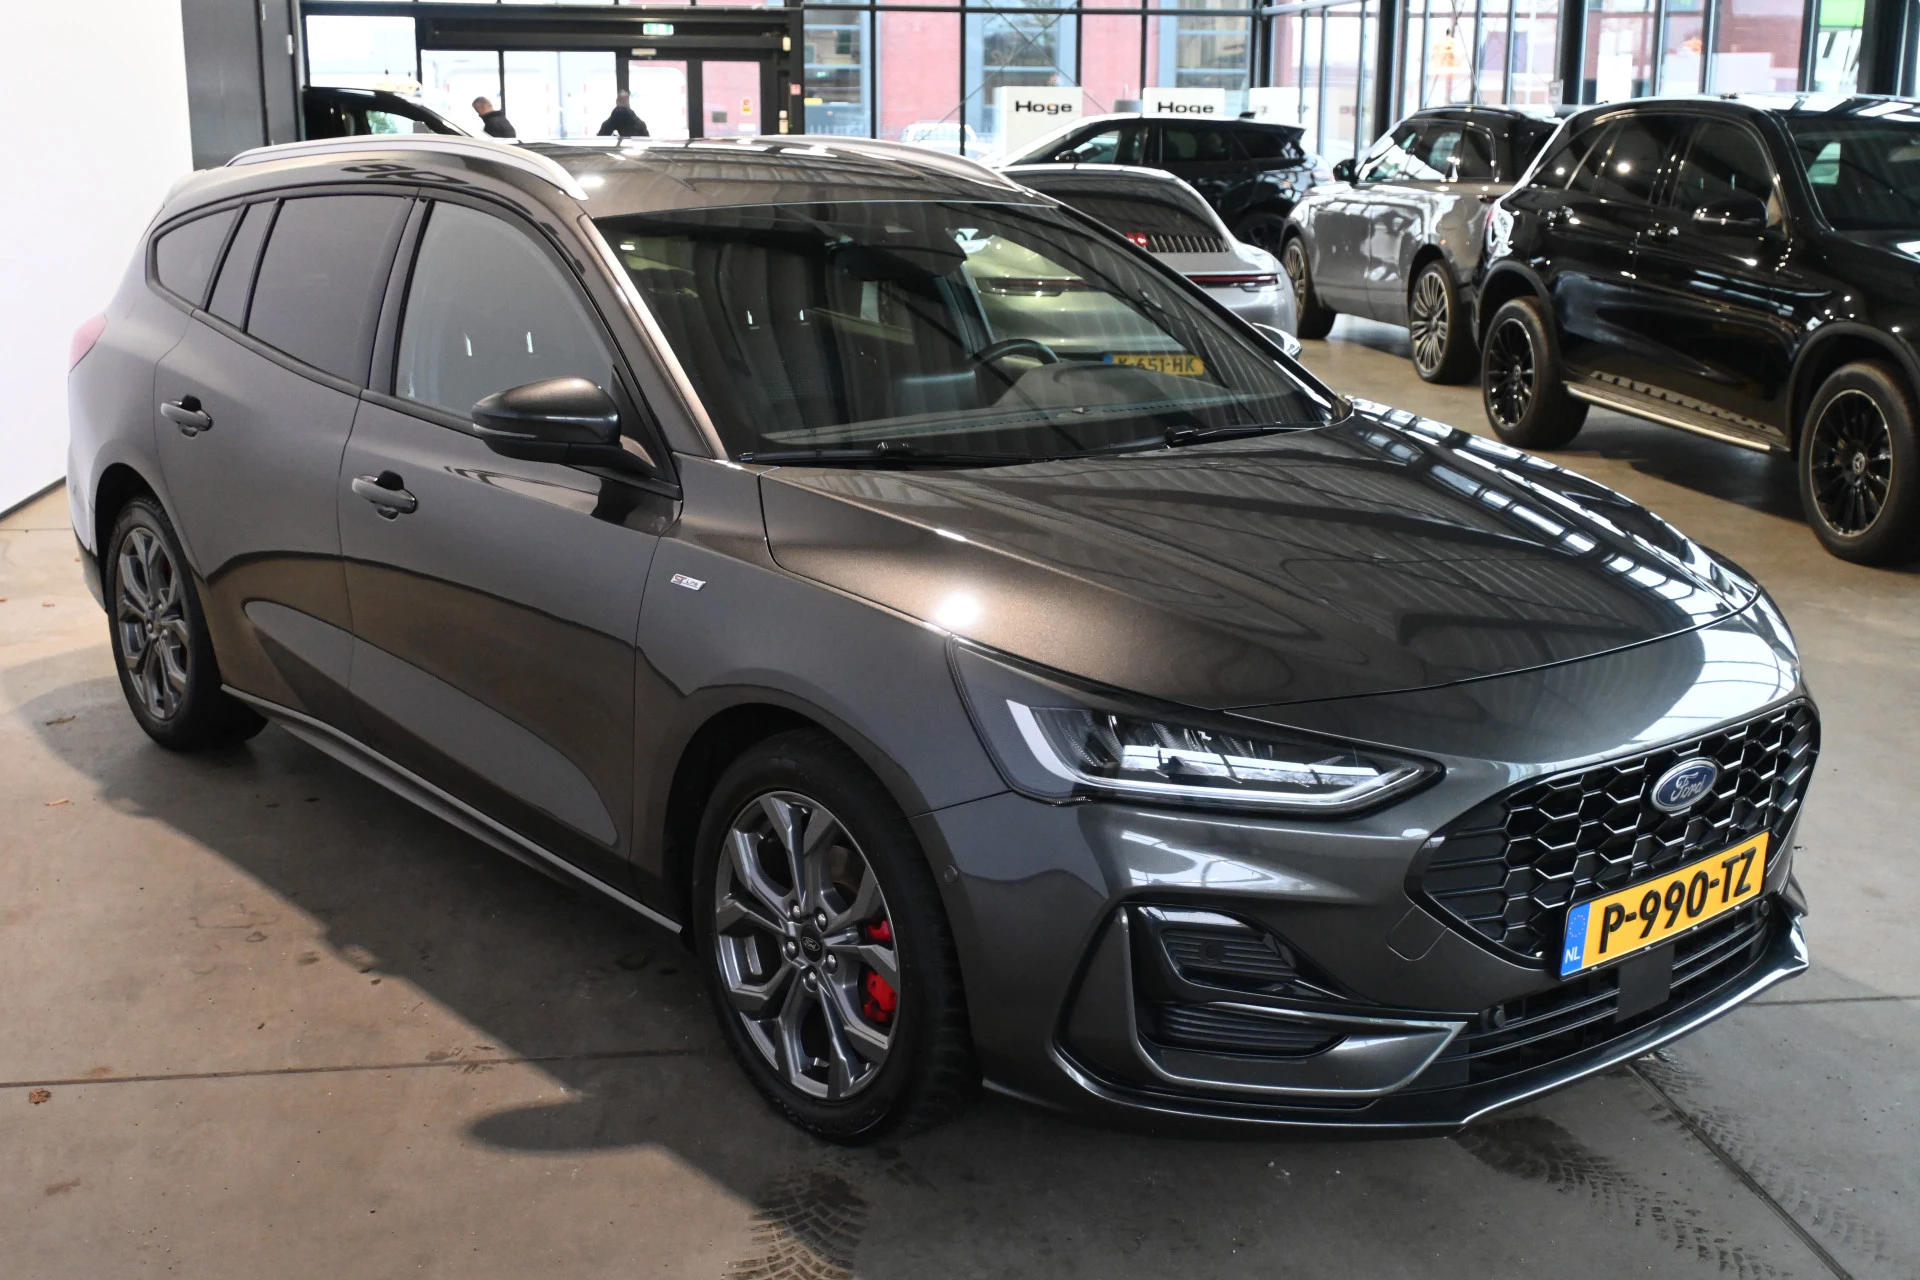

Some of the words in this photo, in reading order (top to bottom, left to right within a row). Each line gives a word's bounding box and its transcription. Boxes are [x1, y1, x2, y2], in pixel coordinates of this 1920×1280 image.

[1015, 100, 1073, 115] Hoge
[1670, 773, 1707, 802] Ford
[1599, 846, 1757, 954] P-990-TZ
[1564, 946, 1581, 964] NL
